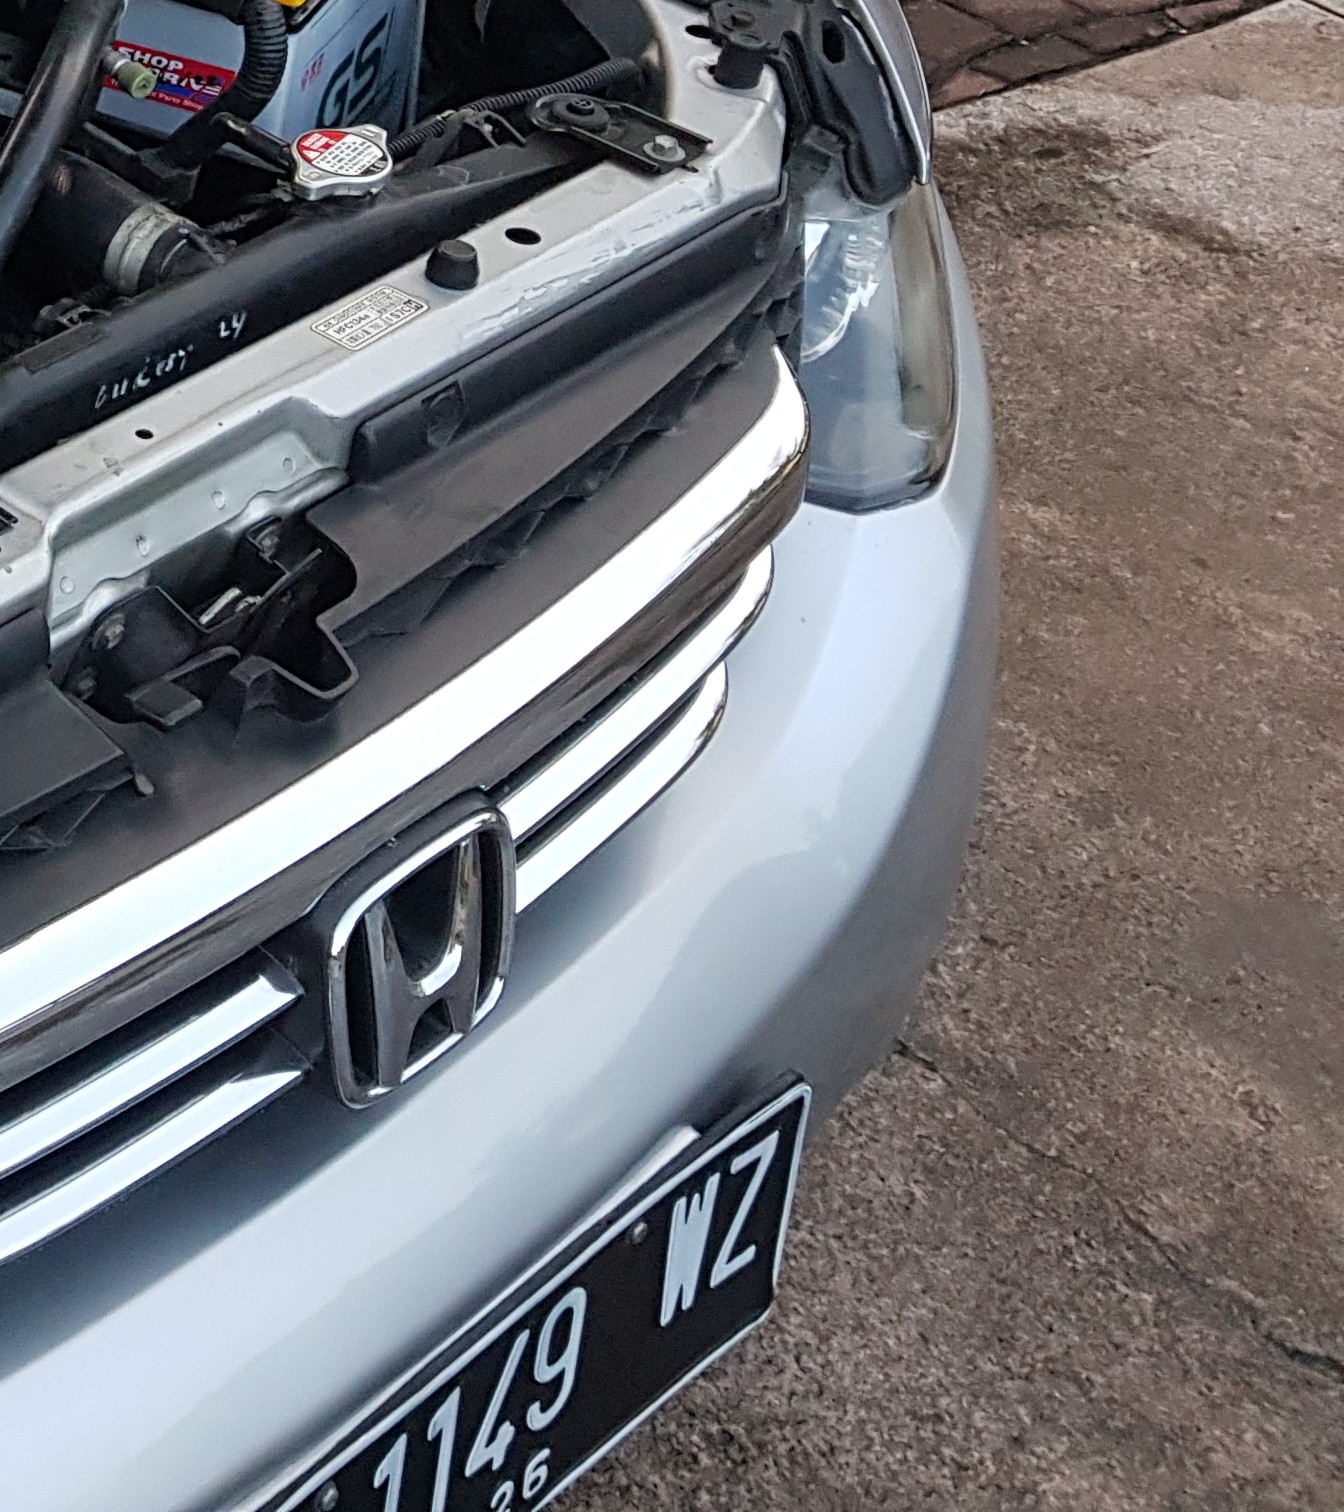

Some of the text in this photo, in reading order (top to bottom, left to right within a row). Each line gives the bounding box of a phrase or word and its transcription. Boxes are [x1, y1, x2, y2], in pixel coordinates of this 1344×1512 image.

[117, 45, 184, 71] SHOP
[315, 12, 389, 128] GS
[372, 1129, 780, 1512] 1149 WZ
[490, 1447, 551, 1512] 26
